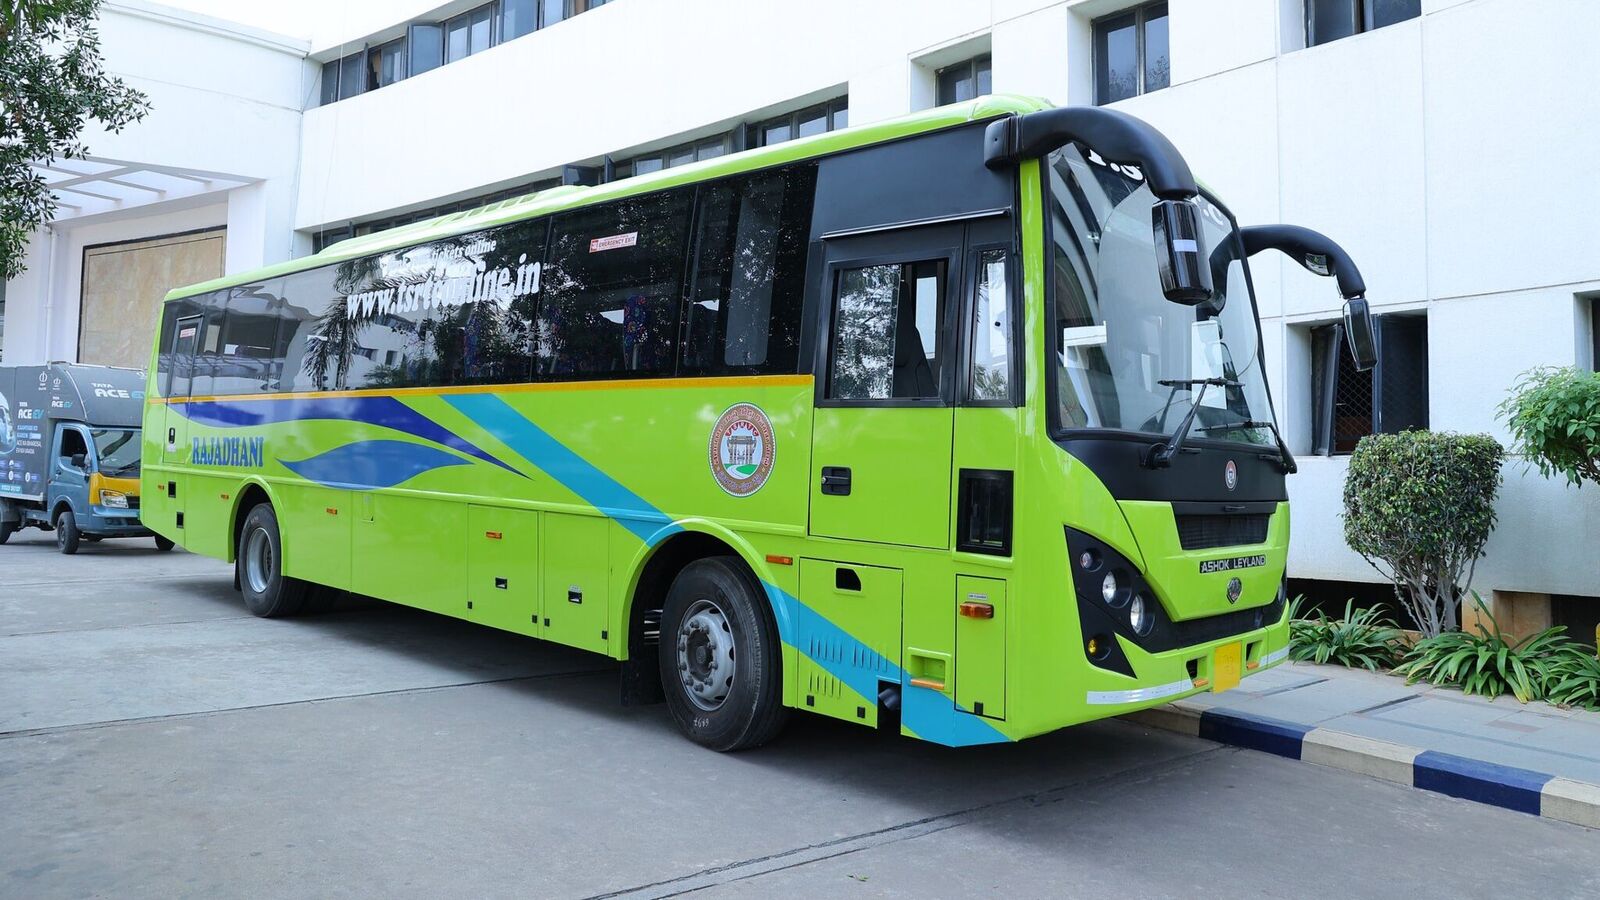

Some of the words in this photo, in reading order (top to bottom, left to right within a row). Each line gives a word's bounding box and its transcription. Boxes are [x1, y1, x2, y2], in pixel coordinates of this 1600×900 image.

[464, 238, 497, 257] online
[94, 388, 130, 399] ACE
[51, 400, 64, 408] ACE
[17, 408, 32, 419] ACE
[32, 409, 45, 420] EV
[192, 436, 264, 467] RAJADHANI
[1201, 560, 1230, 573] ASHOK
[1233, 556, 1265, 568] LEYLAND
